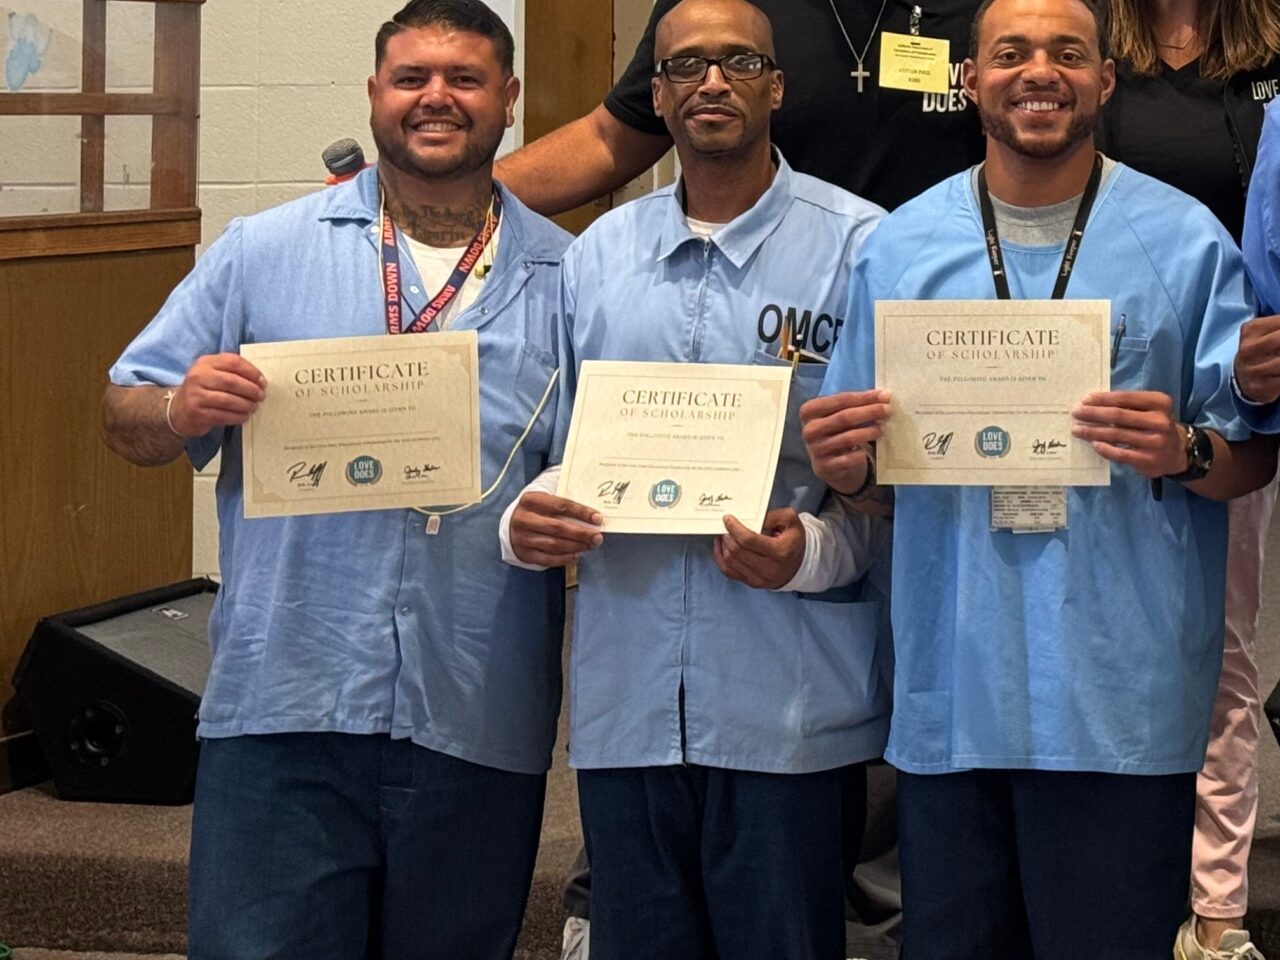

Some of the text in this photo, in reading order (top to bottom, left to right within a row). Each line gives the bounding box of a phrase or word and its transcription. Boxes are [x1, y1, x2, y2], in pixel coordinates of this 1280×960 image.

[1251, 79, 1279, 100] LOVE
[383, 214, 396, 246] ARMS
[459, 242, 483, 273] DOWN
[385, 262, 398, 303] DOWN
[433, 284, 456, 310] ARMS
[411, 307, 437, 333] DOW
[926, 330, 1060, 346] CERTIFICATE
[926, 350, 1055, 360] OF SCHOLARSHIP
[294, 360, 430, 385] CERTIFICATE
[294, 380, 425, 399] OF SCHOLARSHIP
[622, 389, 743, 409] CERTIFICATE
[620, 408, 736, 421] OF SCHOLARSHIP
[982, 431, 1003, 441] LOVE
[982, 441, 1004, 451] DOES
[353, 460, 375, 470] LOVE
[353, 470, 375, 480] DOES
[656, 484, 676, 493] LOVE
[655, 493, 675, 502] DOES
